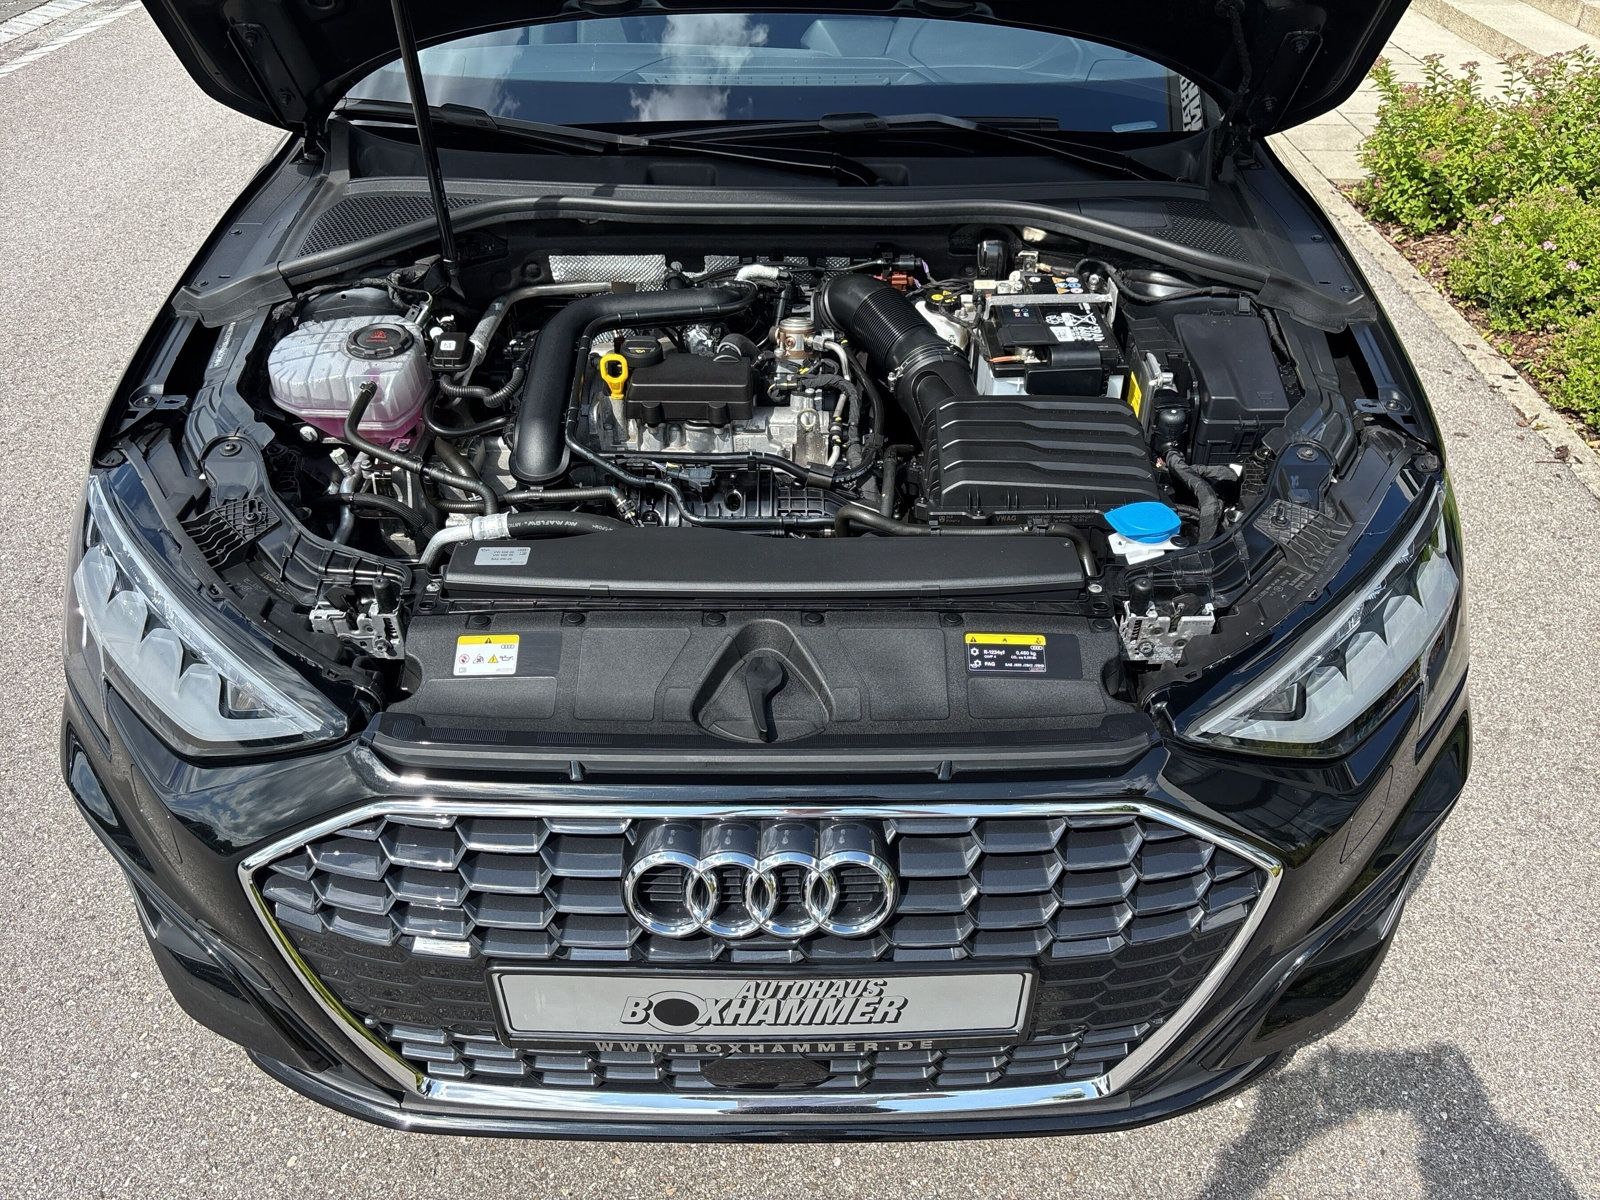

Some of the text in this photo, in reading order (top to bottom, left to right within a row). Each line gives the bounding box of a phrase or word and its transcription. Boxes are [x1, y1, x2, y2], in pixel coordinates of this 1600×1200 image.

[735, 978, 888, 999] AUTOHAUS
[619, 989, 909, 1034] BOXHAMMER
[595, 1039, 934, 1053] WWW.BOXHAMMER.DE
